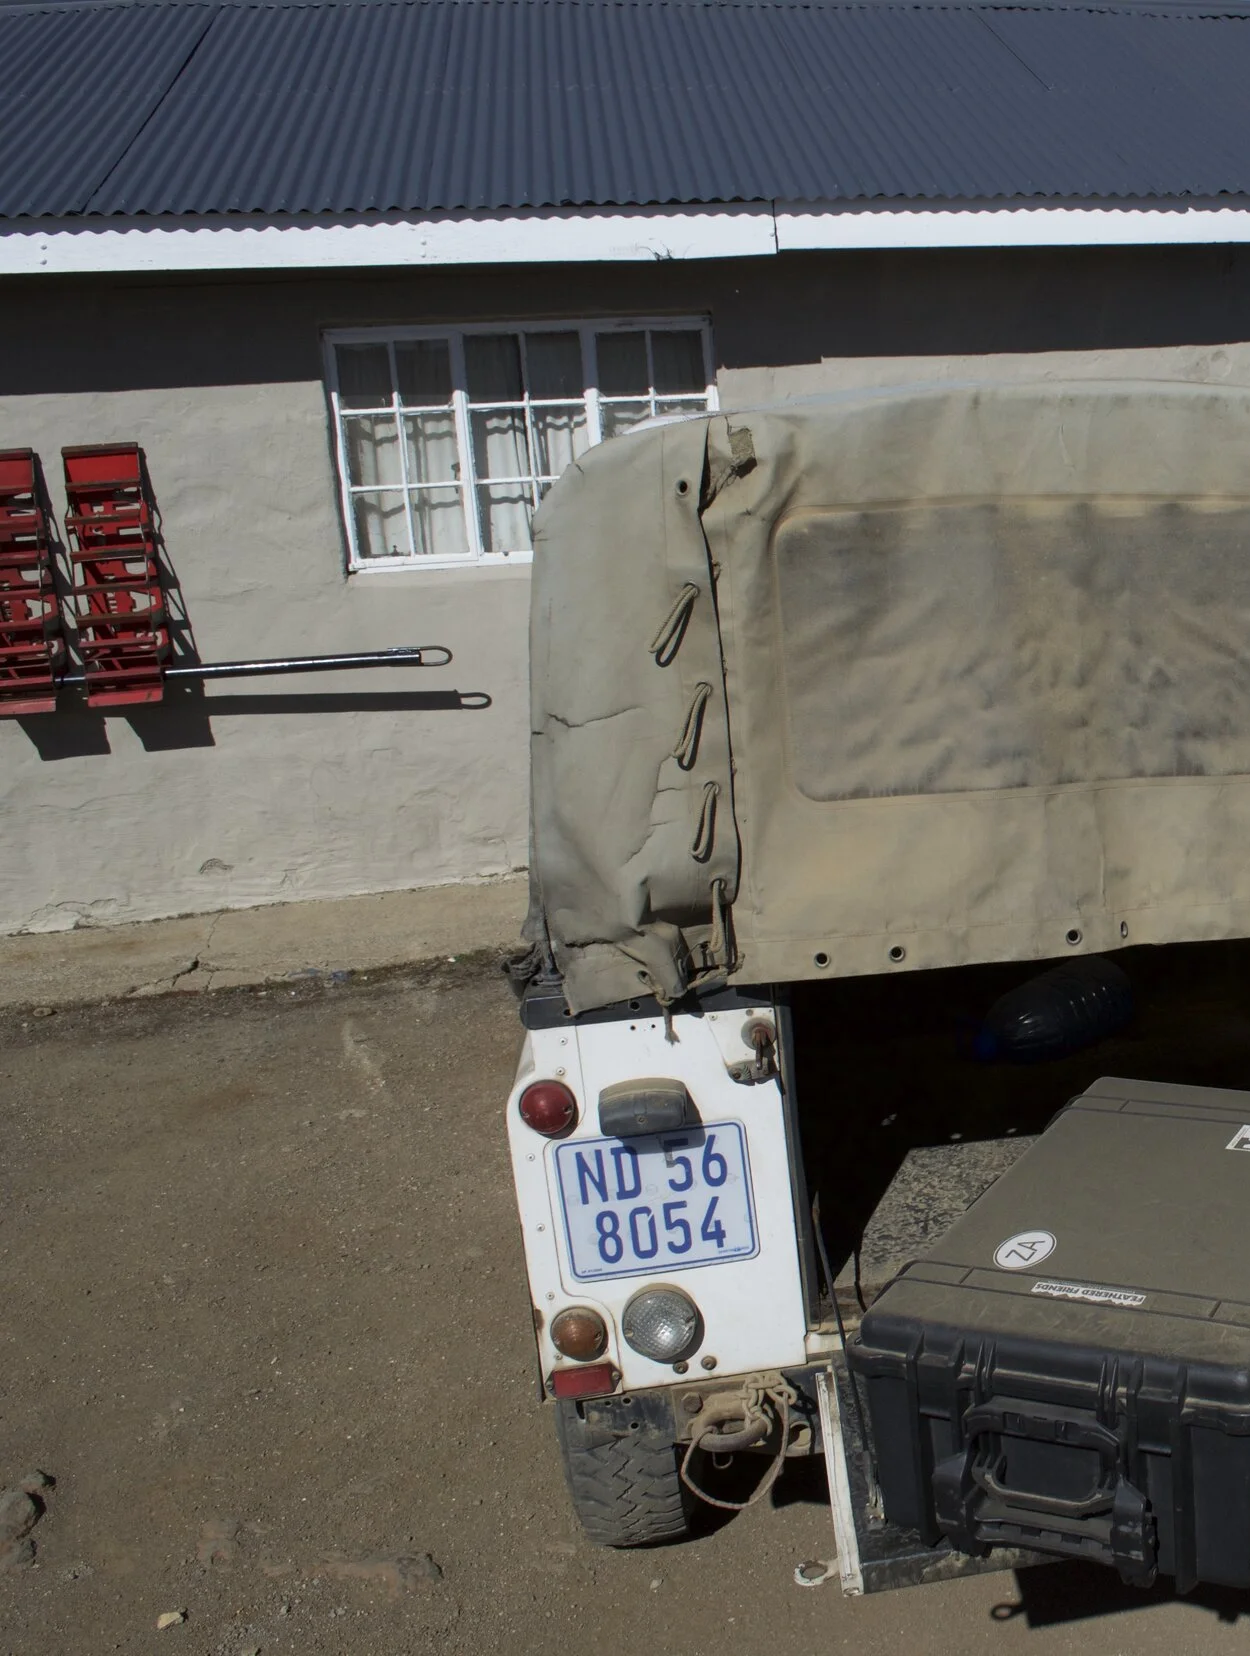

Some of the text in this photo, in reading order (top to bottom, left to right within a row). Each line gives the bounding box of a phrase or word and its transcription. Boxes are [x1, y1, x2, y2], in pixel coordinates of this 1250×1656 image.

[574, 1133, 729, 1206] ND 56
[595, 1195, 727, 1265] 8054
[1004, 1239, 1046, 1263] ZA
[1035, 1282, 1144, 1304] FEATHERED FRIENDS
